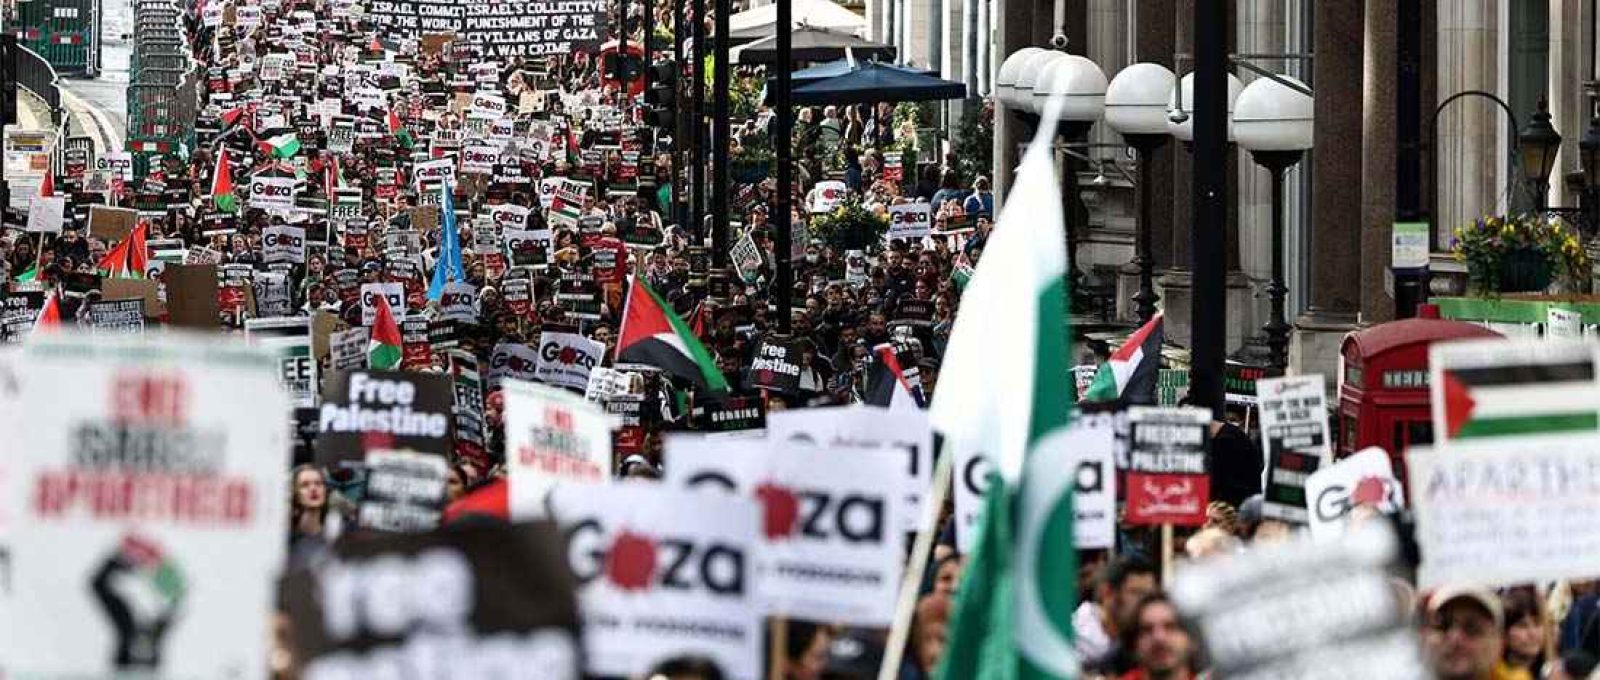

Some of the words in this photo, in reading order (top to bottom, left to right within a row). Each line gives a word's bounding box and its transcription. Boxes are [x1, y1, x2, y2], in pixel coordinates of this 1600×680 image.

[372, 1, 415, 14] ISRAEL
[467, 2, 525, 16] ISRAEL'S
[527, 0, 606, 13] COLLECTIVE
[398, 15, 417, 27] THE
[421, 17, 461, 30] WORLD
[466, 16, 547, 29] PUNISHMENT
[551, 15, 567, 27] OF
[571, 13, 595, 26] THE
[467, 31, 541, 43] CIVILIANS
[544, 29, 560, 40] OF
[563, 28, 598, 39] GAZA
[487, 44, 496, 56] A
[498, 44, 527, 55] WAR
[529, 41, 571, 55] CRIME
[349, 372, 417, 405] Free
[319, 402, 447, 437] Palestine
